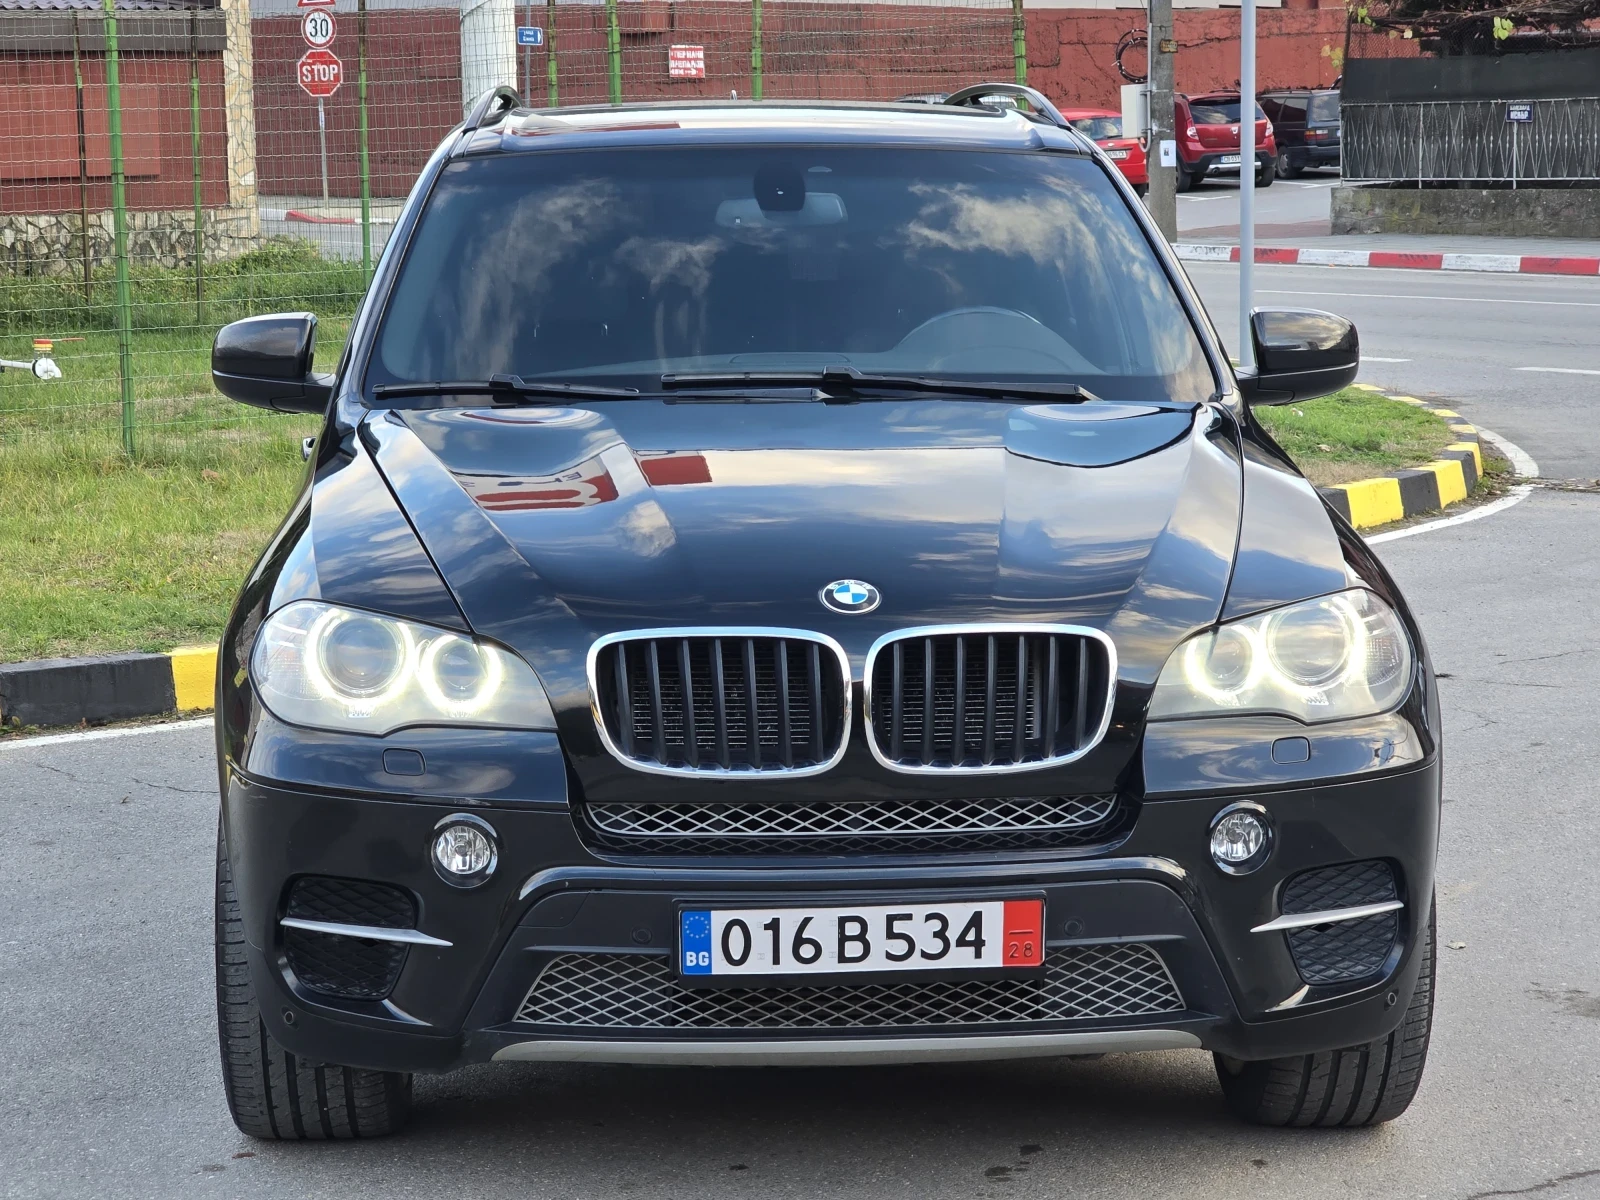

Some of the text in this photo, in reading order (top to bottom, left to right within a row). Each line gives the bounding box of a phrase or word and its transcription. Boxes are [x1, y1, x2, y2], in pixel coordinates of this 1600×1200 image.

[309, 18, 329, 38] 30
[302, 64, 338, 82] STOP
[1009, 941, 1033, 958] 28
[686, 951, 709, 967] BG
